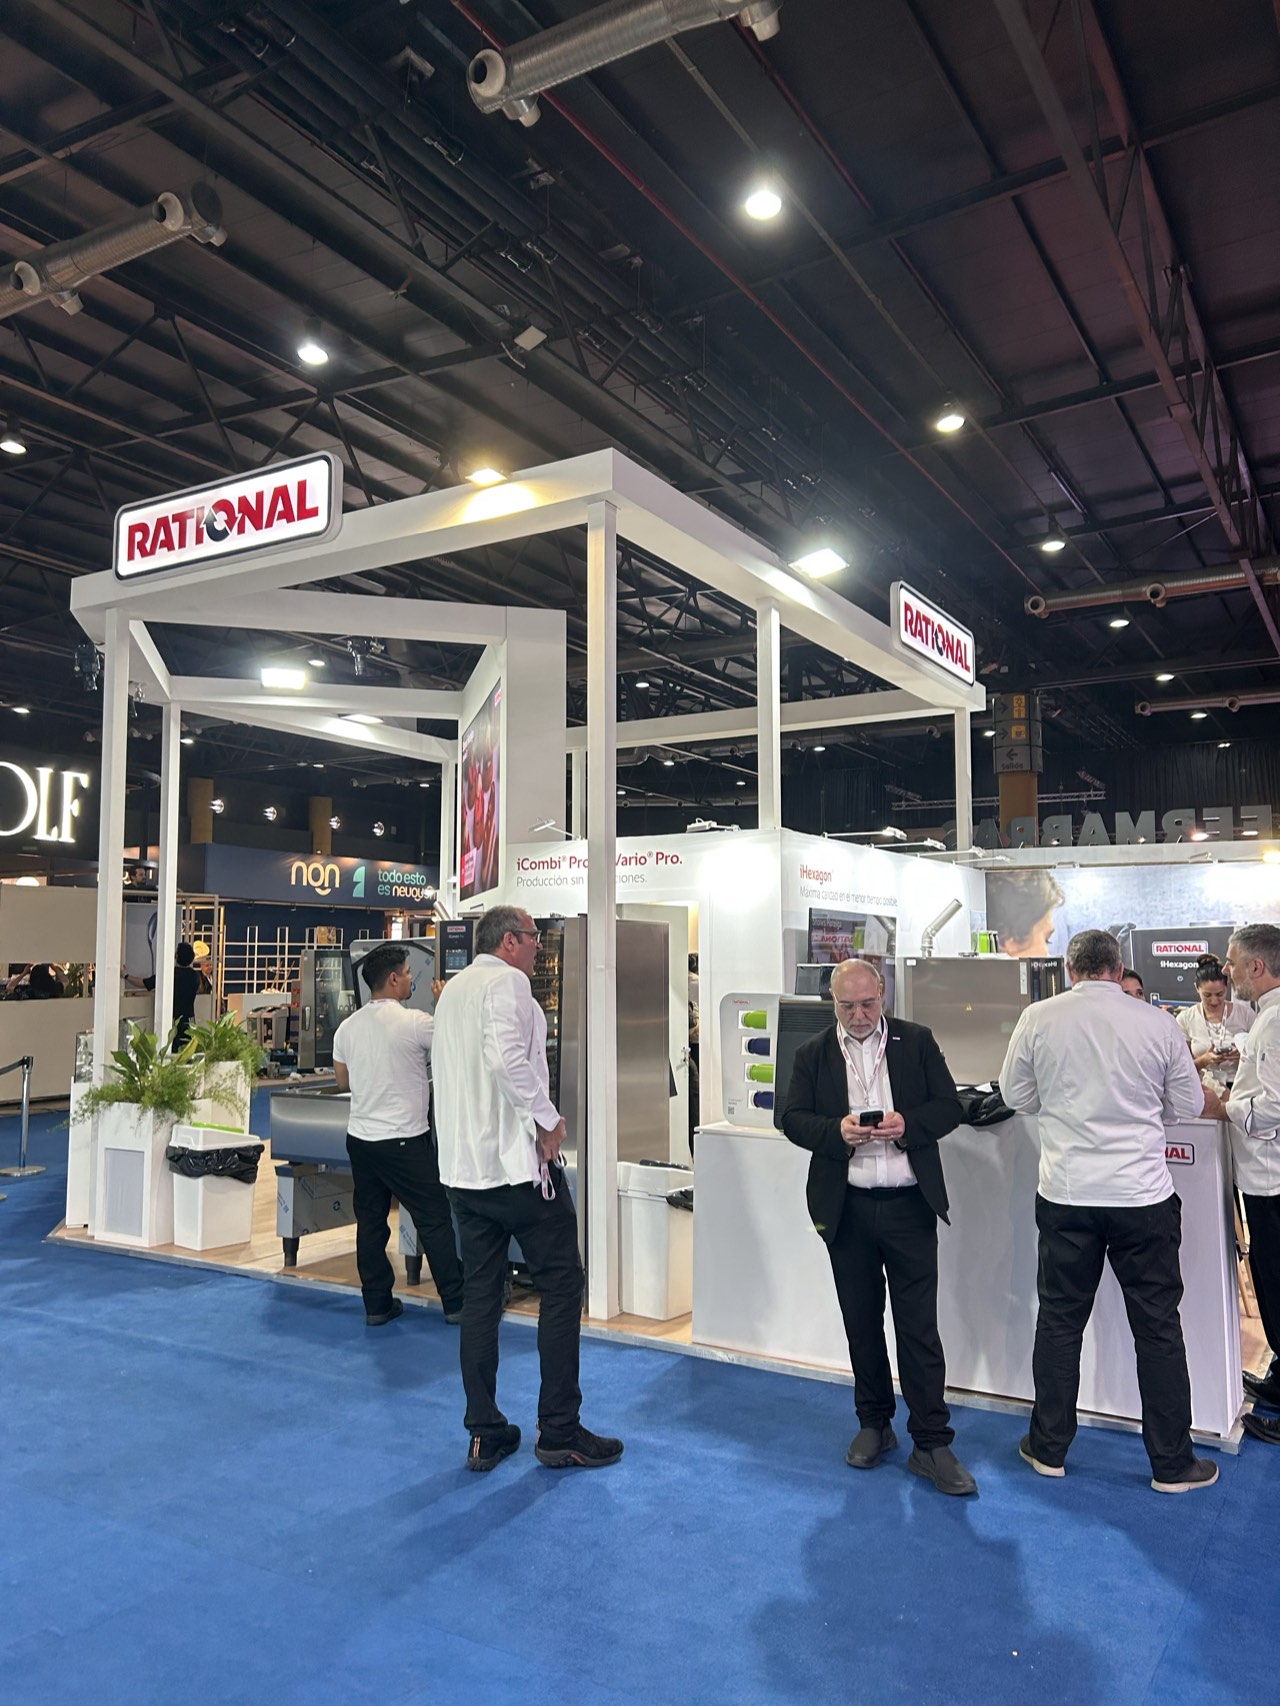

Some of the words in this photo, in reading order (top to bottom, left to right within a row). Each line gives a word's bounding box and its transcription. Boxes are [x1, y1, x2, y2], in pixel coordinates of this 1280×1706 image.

[127, 479, 319, 561] RATIONAL
[904, 600, 971, 673] RATIONAL
[655, 851, 683, 865] Pro.
[377, 868, 403, 884] todo
[403, 872, 427, 886] esto
[516, 874, 568, 887] Producción
[571, 876, 584, 886] sin
[377, 884, 391, 896] es
[1155, 944, 1205, 953] RATIONAL
